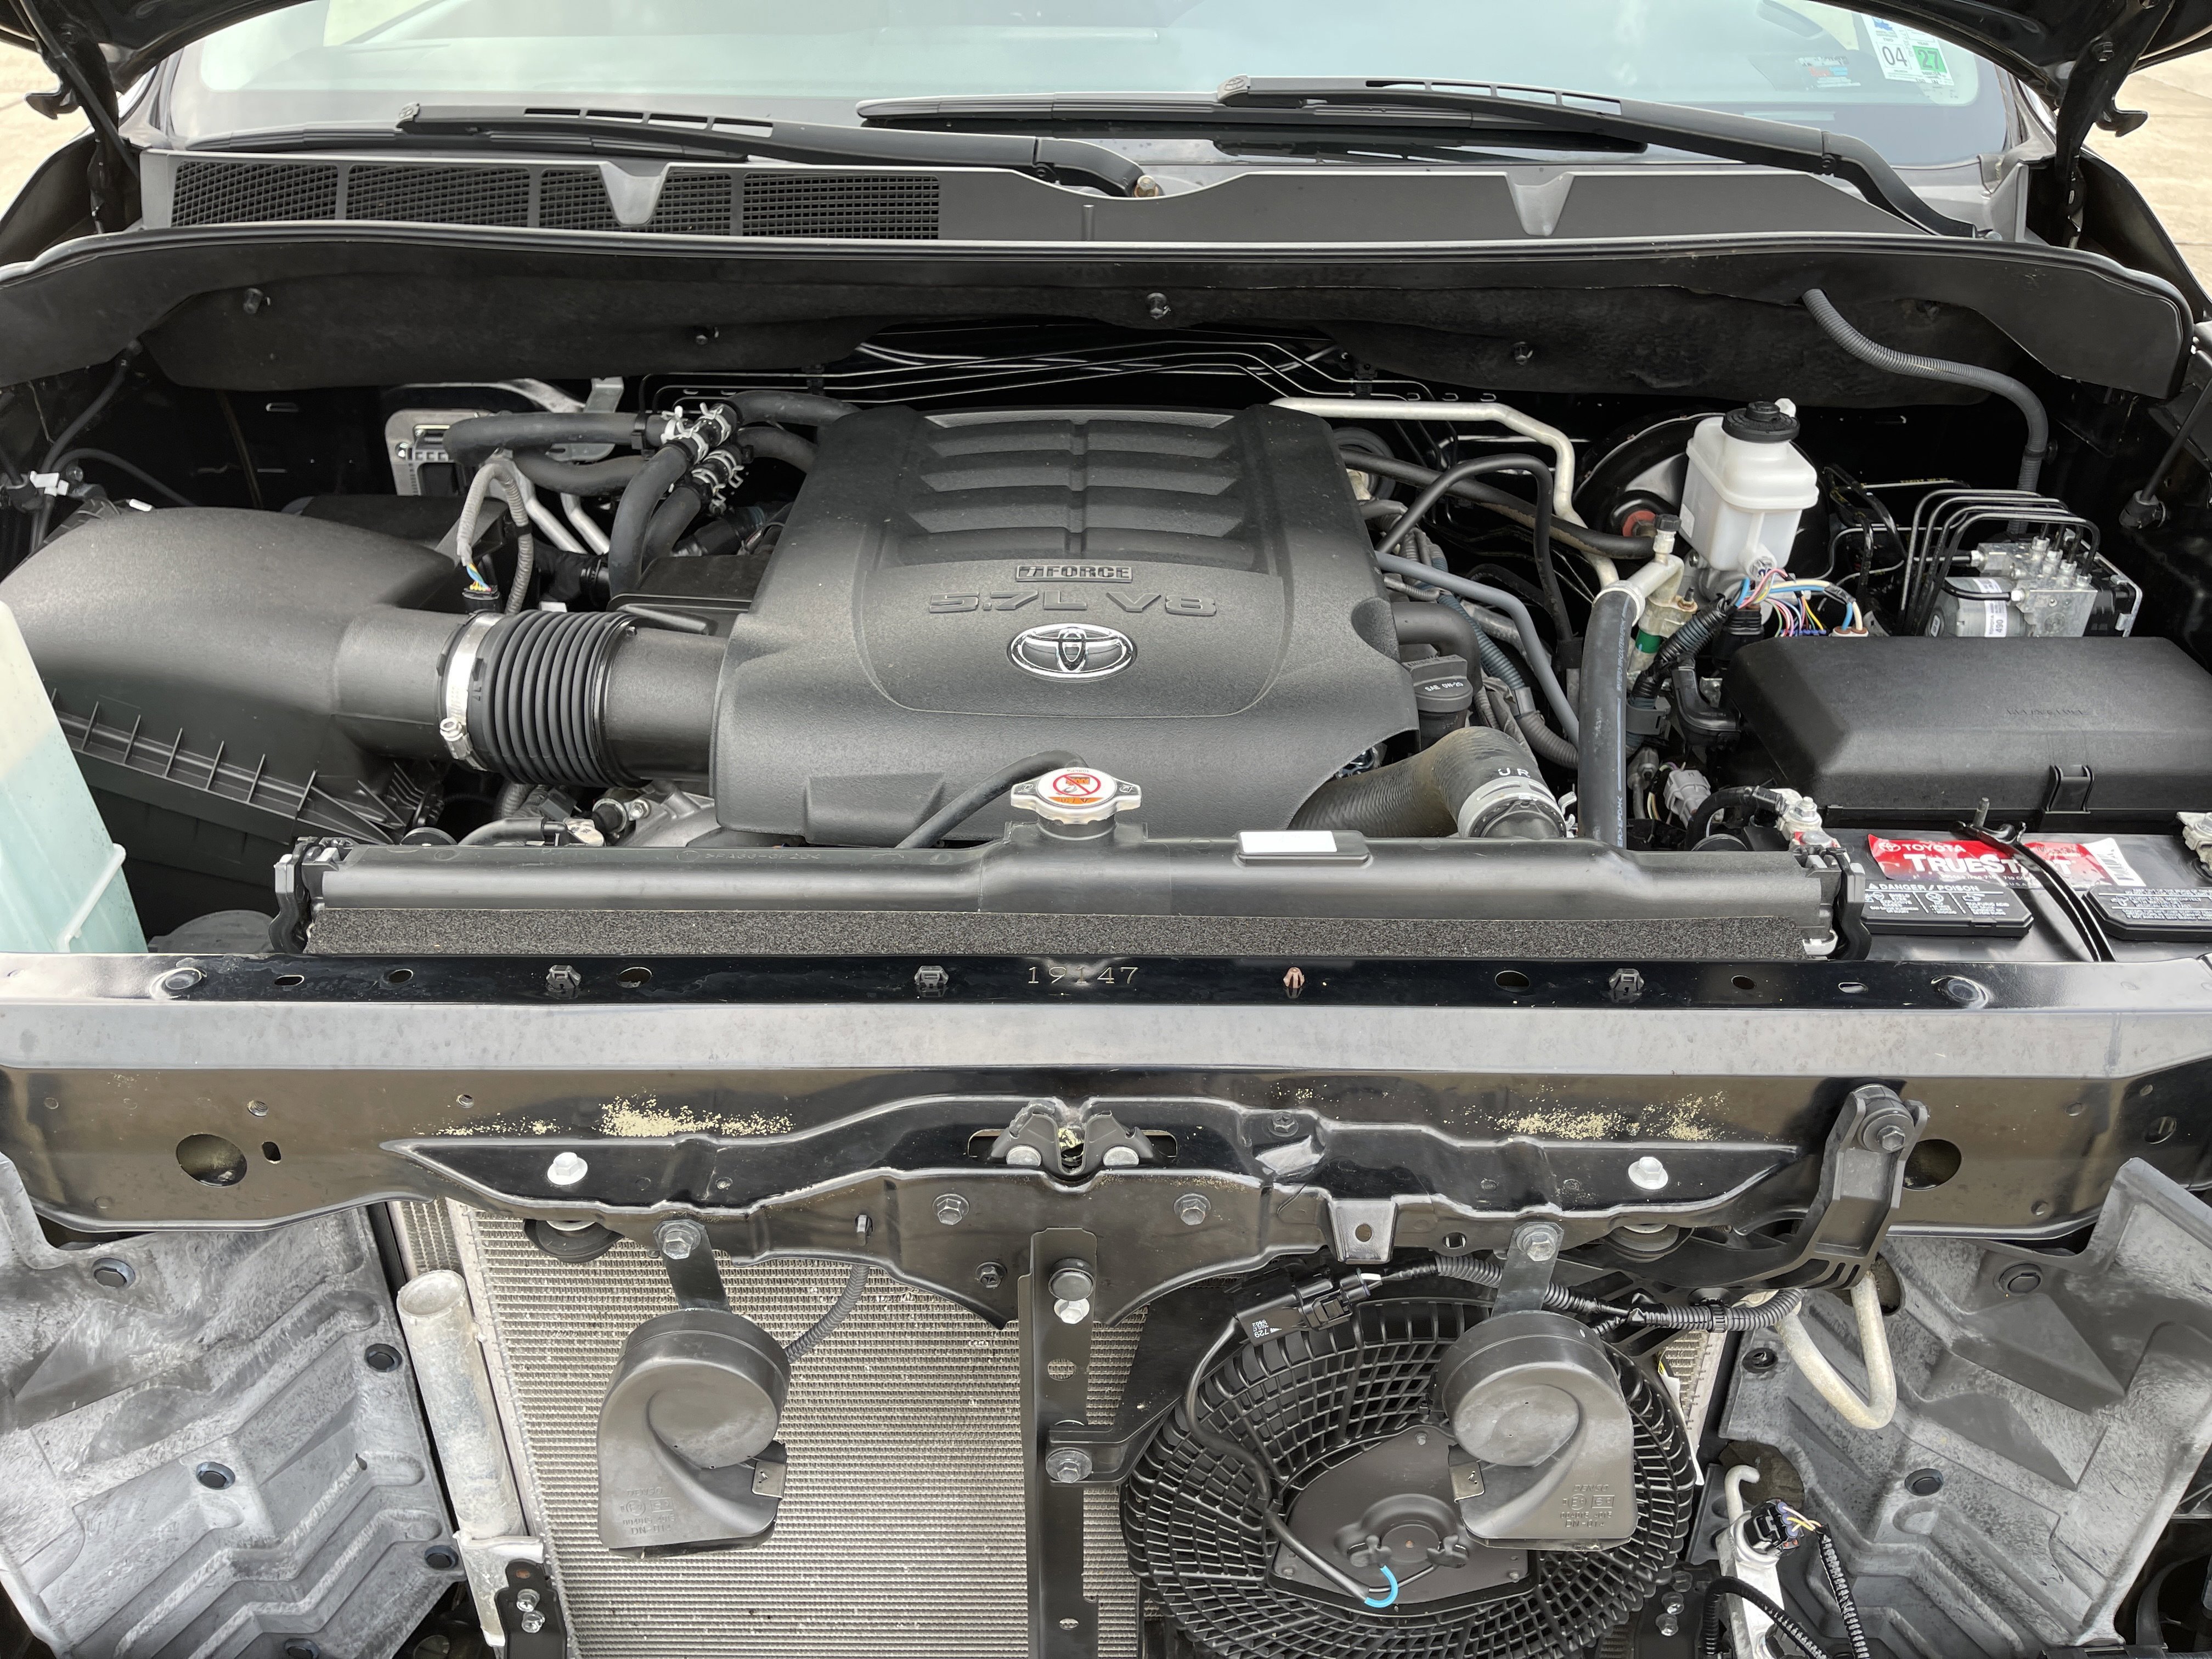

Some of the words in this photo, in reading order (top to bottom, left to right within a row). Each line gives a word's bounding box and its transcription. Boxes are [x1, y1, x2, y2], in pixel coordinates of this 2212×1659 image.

[1882, 46, 1908, 67] 04
[1917, 49, 1939, 70] 27
[928, 590, 1087, 613] 5.7L
[1105, 592, 1218, 616] V8
[1995, 619, 2004, 633] 490
[1901, 843, 1967, 853] TOYOTA
[1028, 966, 1139, 984] 19147
[627, 1487, 663, 1497] DENSO
